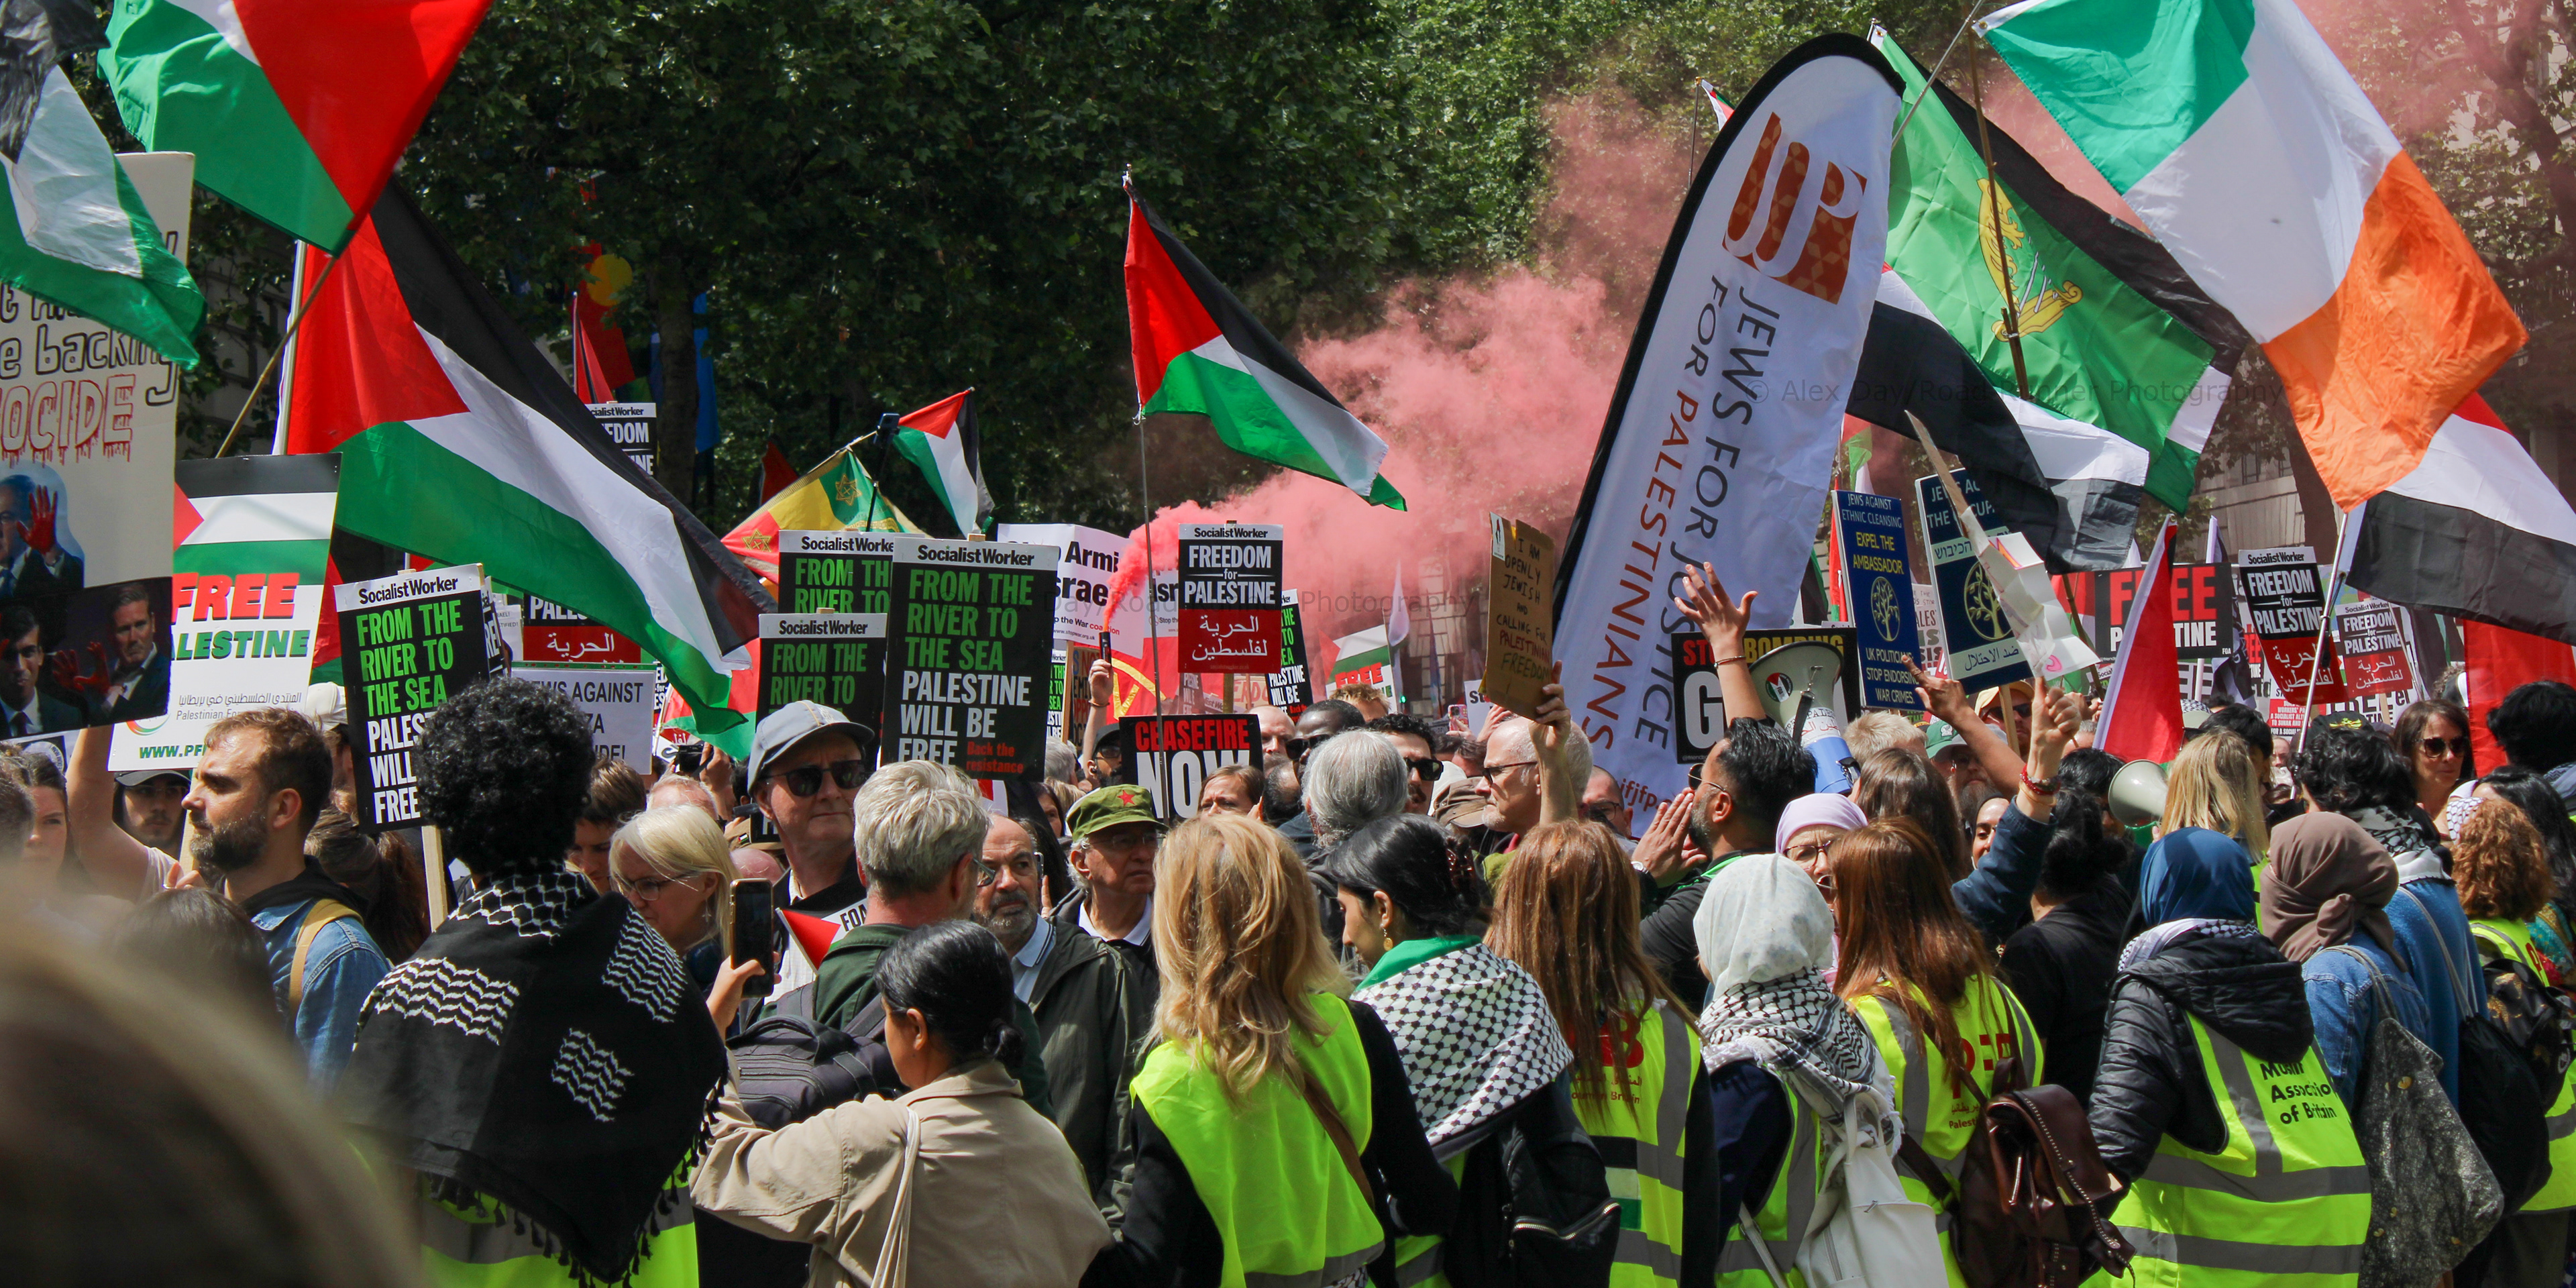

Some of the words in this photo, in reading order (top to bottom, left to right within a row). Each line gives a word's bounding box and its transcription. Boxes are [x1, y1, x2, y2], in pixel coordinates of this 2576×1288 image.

[1684, 275, 1728, 377] FOR
[1713, 286, 1780, 425] JEWS
[0, 374, 136, 463] OCIDE
[591, 407, 615, 416] cialist
[1685, 436, 1740, 539] FOR
[1848, 494, 1864, 506] JEWS
[1866, 496, 1892, 510] AGAINST
[1842, 509, 1866, 523] ETHNIC
[1868, 513, 1902, 528] CLEANSING
[1927, 511, 1950, 529] THE
[855, 538, 894, 552] Worke
[1519, 538, 1524, 553] I
[1529, 543, 1540, 561] AM
[1856, 532, 1880, 549] EXPEL
[1880, 535, 1895, 551] THE
[1065, 541, 1119, 573] Armi
[1189, 545, 1271, 568] FREEDOM
[1854, 554, 1904, 575] AMBASSADOR
[796, 558, 853, 586] FROM
[861, 560, 890, 588] TH
[1224, 569, 1238, 580] for
[1505, 555, 1540, 585] OPENLY
[1582, 390, 1699, 749] PALESTINIANS
[909, 569, 979, 602] FROM
[988, 574, 1034, 605] THE
[1055, 576, 1108, 606] srae
[1185, 581, 1275, 604] PALESTINE
[1503, 574, 1540, 603] JEWISH
[2247, 570, 2315, 596] FREEDOM
[172, 572, 300, 625] FREE
[794, 588, 854, 613] RIVER
[861, 590, 890, 613] TO
[1517, 602, 1527, 615] AND
[2281, 595, 2293, 607] for
[356, 607, 413, 647] FROM
[419, 600, 463, 636] THE
[907, 603, 979, 636] RIVER
[987, 607, 1018, 638] TO
[1061, 616, 1073, 625] the
[1075, 618, 1089, 628] War
[1199, 615, 1258, 637] الحرية
[1497, 614, 1531, 634] CALLING
[1536, 627, 1548, 645] FOR
[2343, 612, 2396, 633] FREEDOM
[2367, 629, 2376, 637] for
[172, 629, 311, 661] LESTINE
[547, 633, 614, 658] الحرية
[1500, 629, 1550, 663] PALESTINIAN
[2110, 621, 2217, 651] PTINE
[2344, 633, 2402, 655] PALESTINE
[360, 643, 417, 682] RIVER
[423, 637, 453, 672] TO
[772, 643, 827, 673] FROM
[833, 643, 868, 672] THE
[905, 637, 951, 668] THE
[959, 639, 1004, 671] SEA
[1192, 638, 1267, 661] لفلسطين
[1866, 647, 1876, 660] UK
[1866, 667, 1883, 680] STOP
[2358, 655, 2396, 673] الحرية
[771, 676, 826, 705] RIVER
[832, 676, 855, 704] TO
[902, 670, 1031, 706] PALESTINE
[2356, 669, 2404, 689] لفلسطين
[362, 681, 401, 716] THE
[405, 674, 447, 710] SEA
[572, 682, 643, 704] AGAINST
[1049, 696, 1061, 710] SEA
[1285, 685, 1300, 704] BE
[1875, 688, 1890, 702] WAR
[176, 710, 223, 720] Palestinian
[901, 704, 958, 737] WILL
[966, 708, 997, 738] BE
[367, 711, 438, 753] PALES
[1135, 719, 1250, 751] CEASEFIRE
[140, 745, 206, 759] WWW.PF
[898, 738, 957, 765] FREE
[967, 741, 994, 756] Back
[996, 742, 1015, 757] the
[370, 751, 417, 788] WILL
[966, 758, 1024, 774] resistance
[374, 786, 421, 824] FREE
[1949, 1118, 1977, 1129] Palest
[2280, 1105, 2299, 1124] of
[2302, 1102, 2337, 1118] Britain
